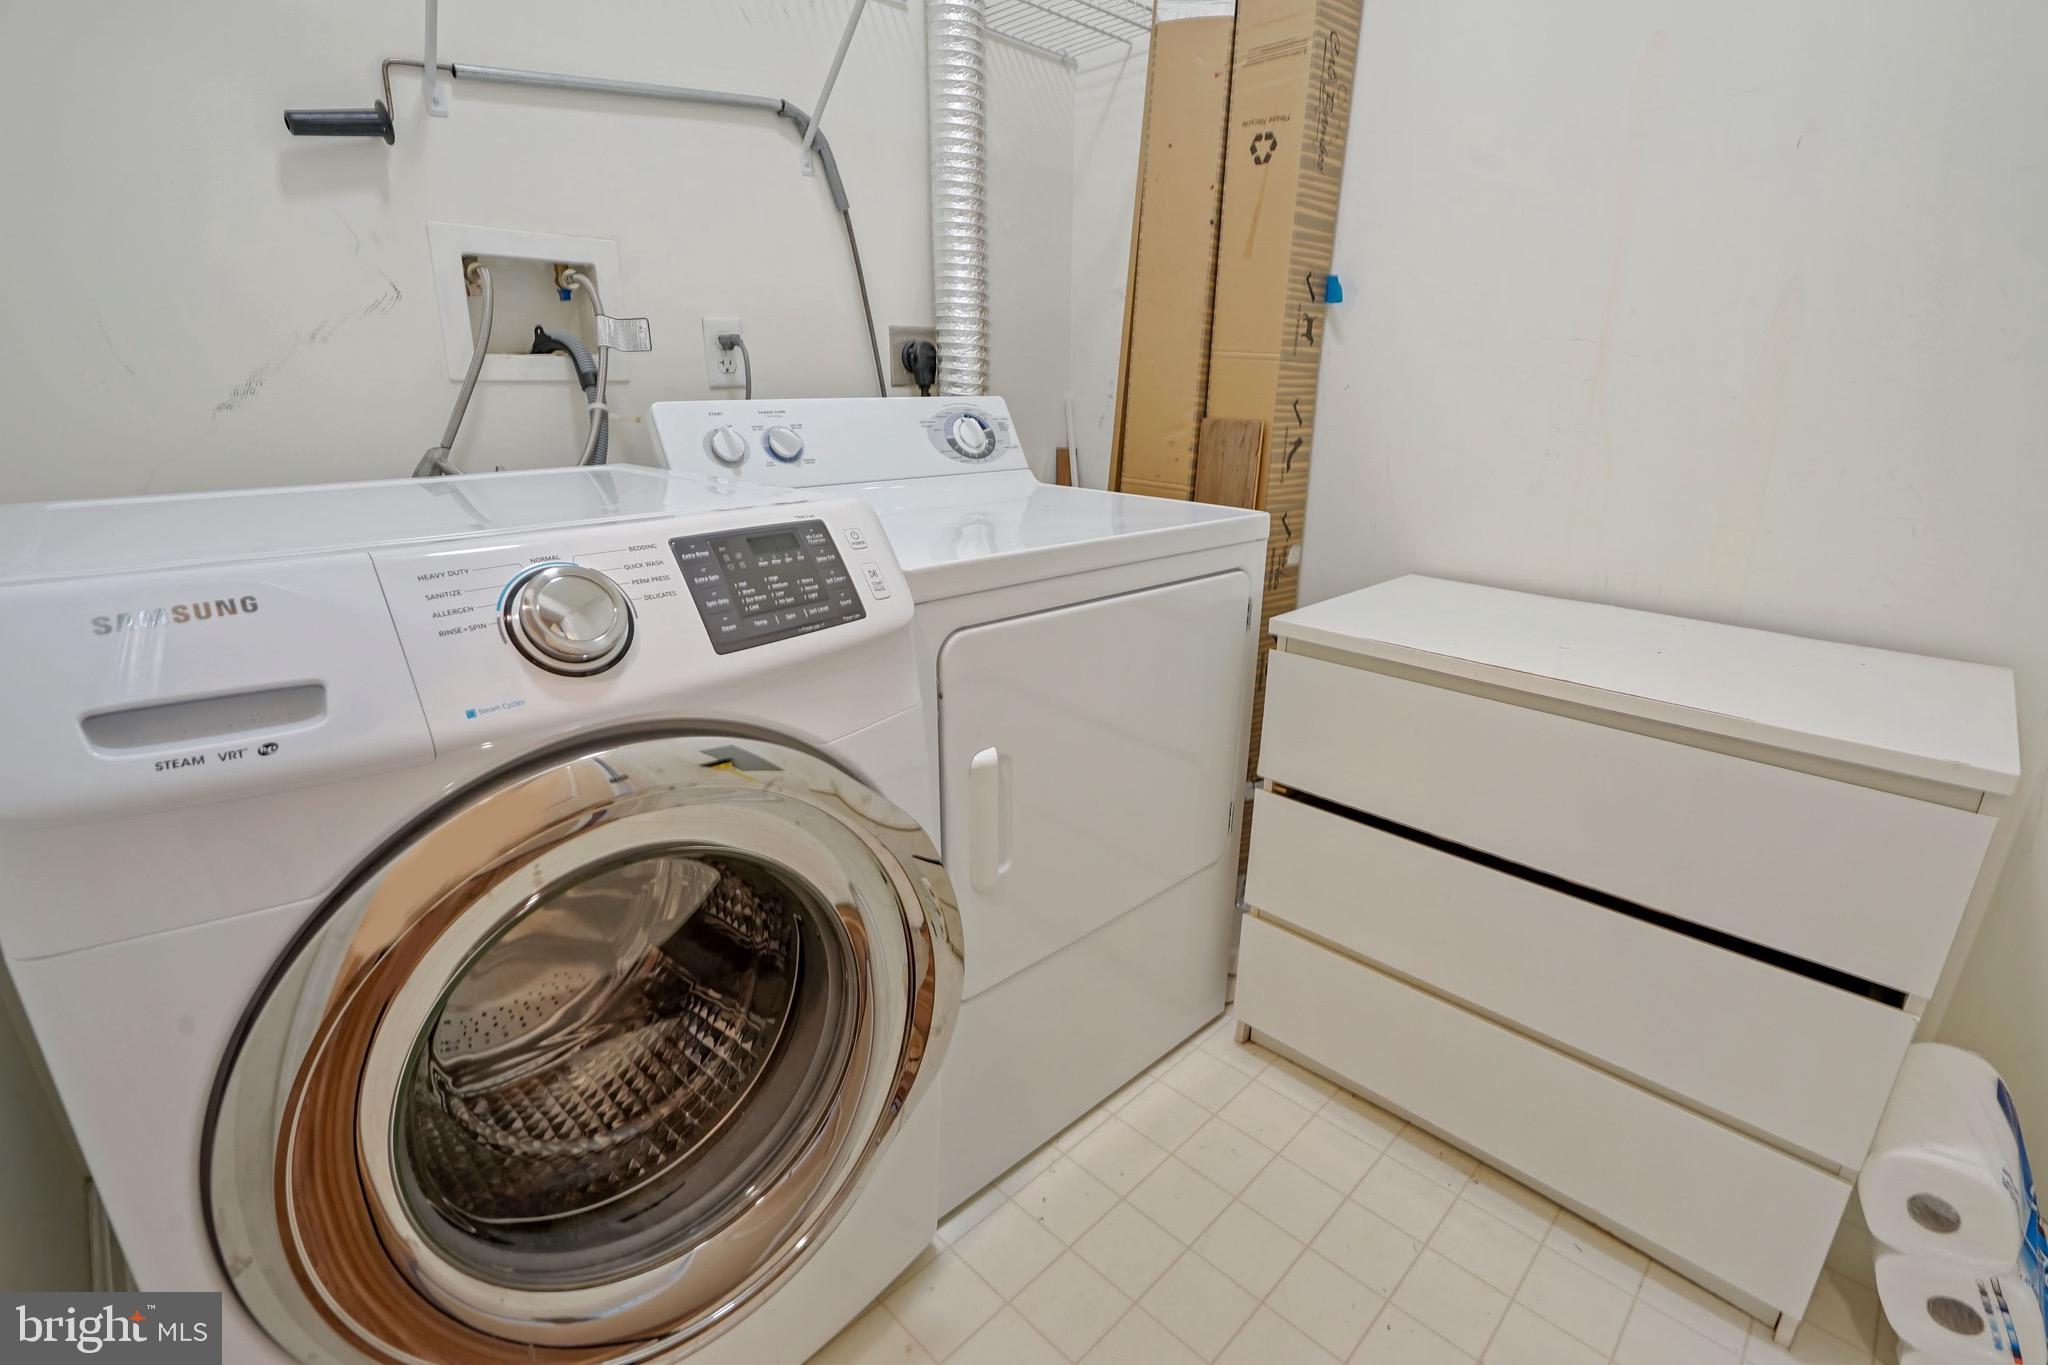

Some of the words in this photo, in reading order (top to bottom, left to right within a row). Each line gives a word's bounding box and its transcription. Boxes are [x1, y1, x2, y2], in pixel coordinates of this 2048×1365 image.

[1241, 117, 1267, 128] Recycle
[1268, 114, 1291, 123] Please
[628, 543, 658, 552] BEDDING
[530, 554, 561, 564] NORMAL
[624, 561, 644, 571] QUICK
[645, 559, 665, 569] WASH
[417, 570, 446, 583] HEAVY
[447, 568, 470, 579] DUTY
[632, 576, 651, 585] PERM
[651, 574, 671, 583] PRESS
[424, 589, 462, 601] SANITIZE
[643, 590, 677, 601] DELICATES
[432, 606, 475, 619] ALLERGEN
[478, 705, 501, 715] Steam
[502, 699, 526, 709] Cycles
[155, 755, 205, 771] STEAM
